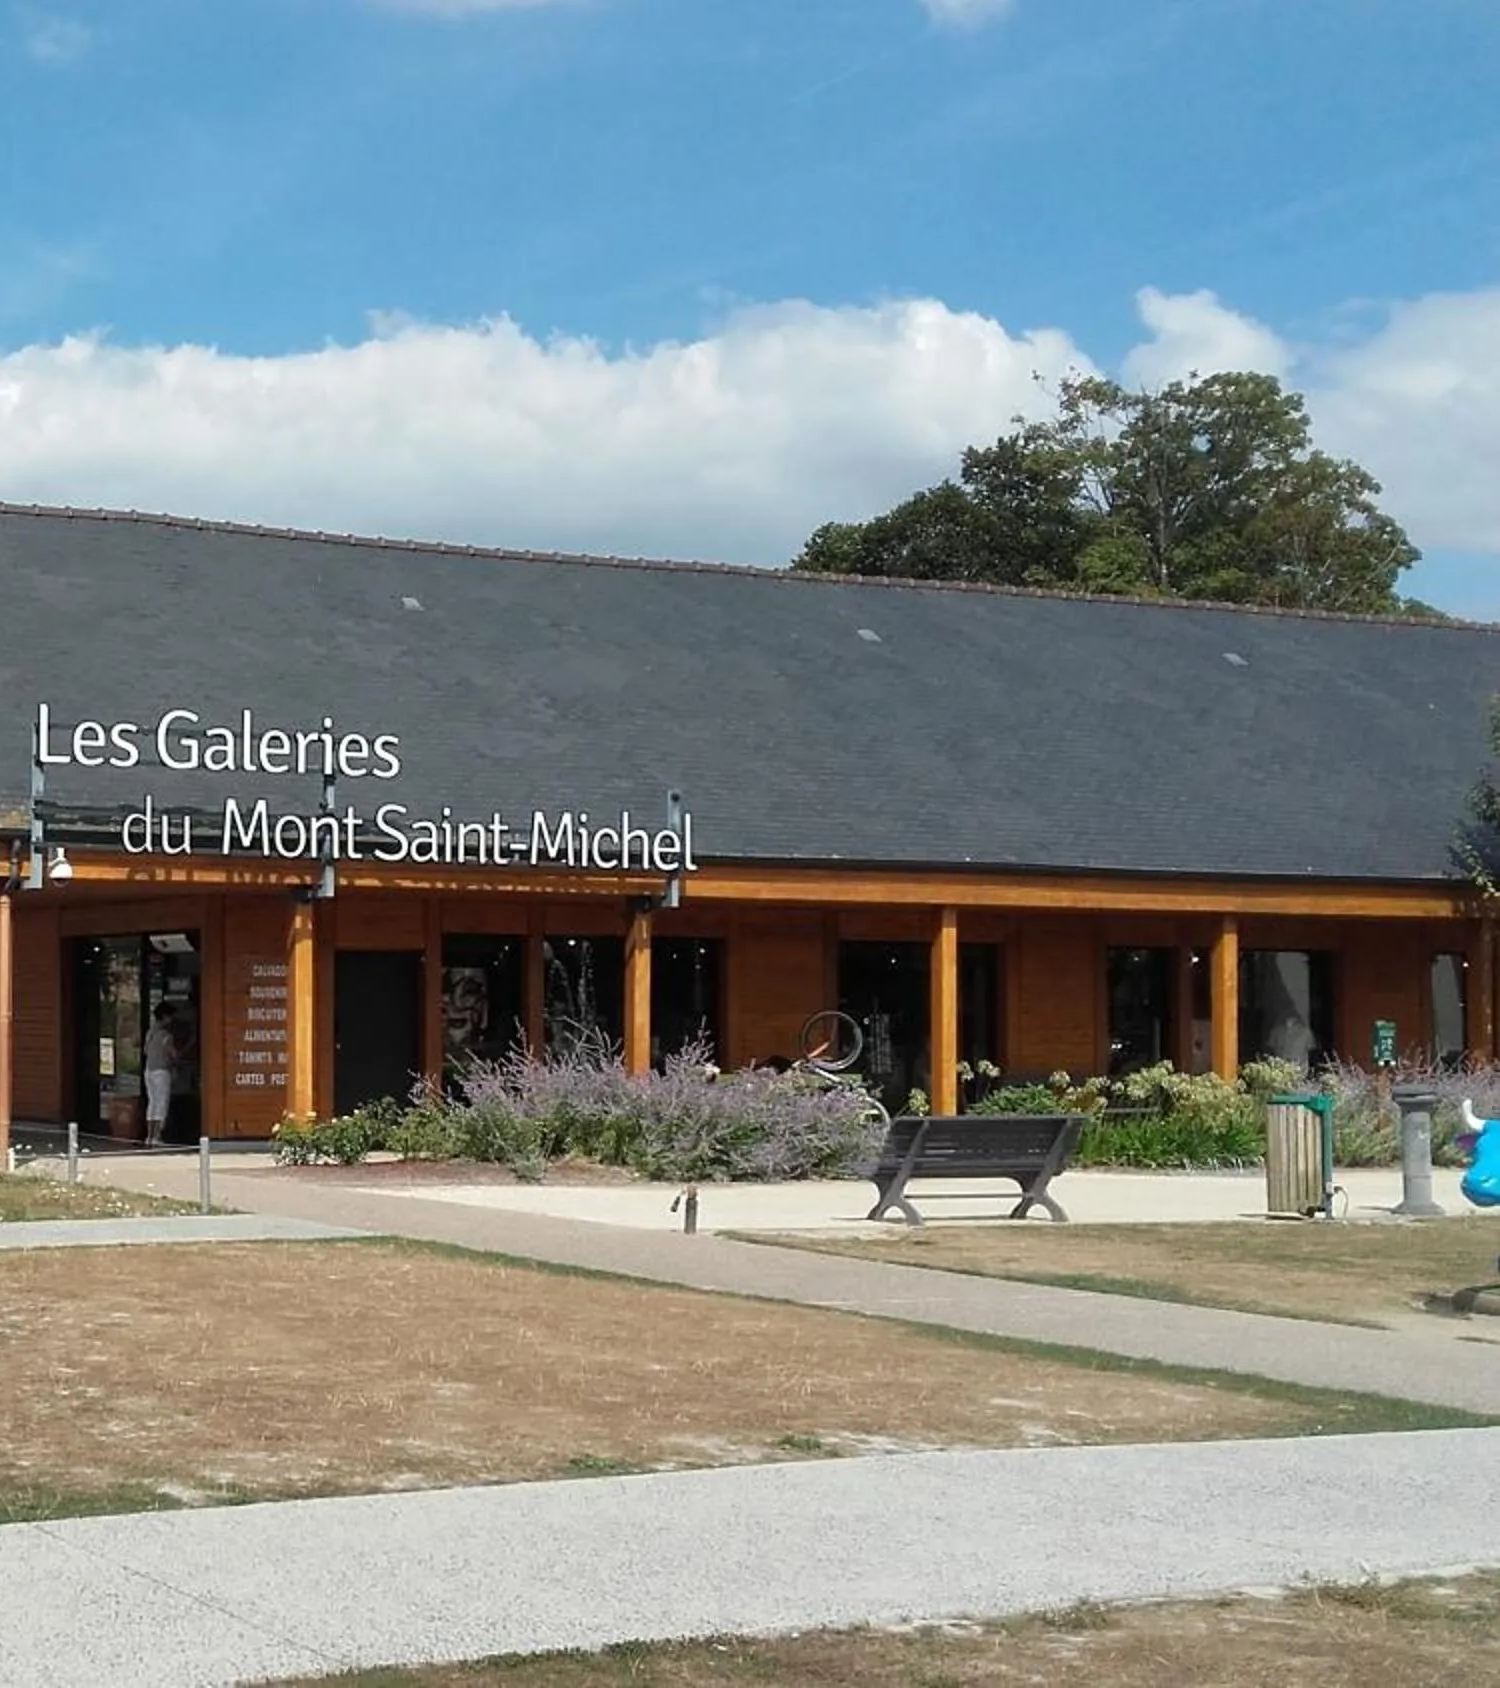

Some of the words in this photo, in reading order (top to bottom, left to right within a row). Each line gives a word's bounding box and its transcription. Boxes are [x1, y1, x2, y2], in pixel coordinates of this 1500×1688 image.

[38, 703, 139, 767] Les
[157, 709, 401, 779] Galeries
[122, 795, 191, 854] du
[222, 798, 363, 860] Mont
[374, 803, 698, 872] Saint-Michel
